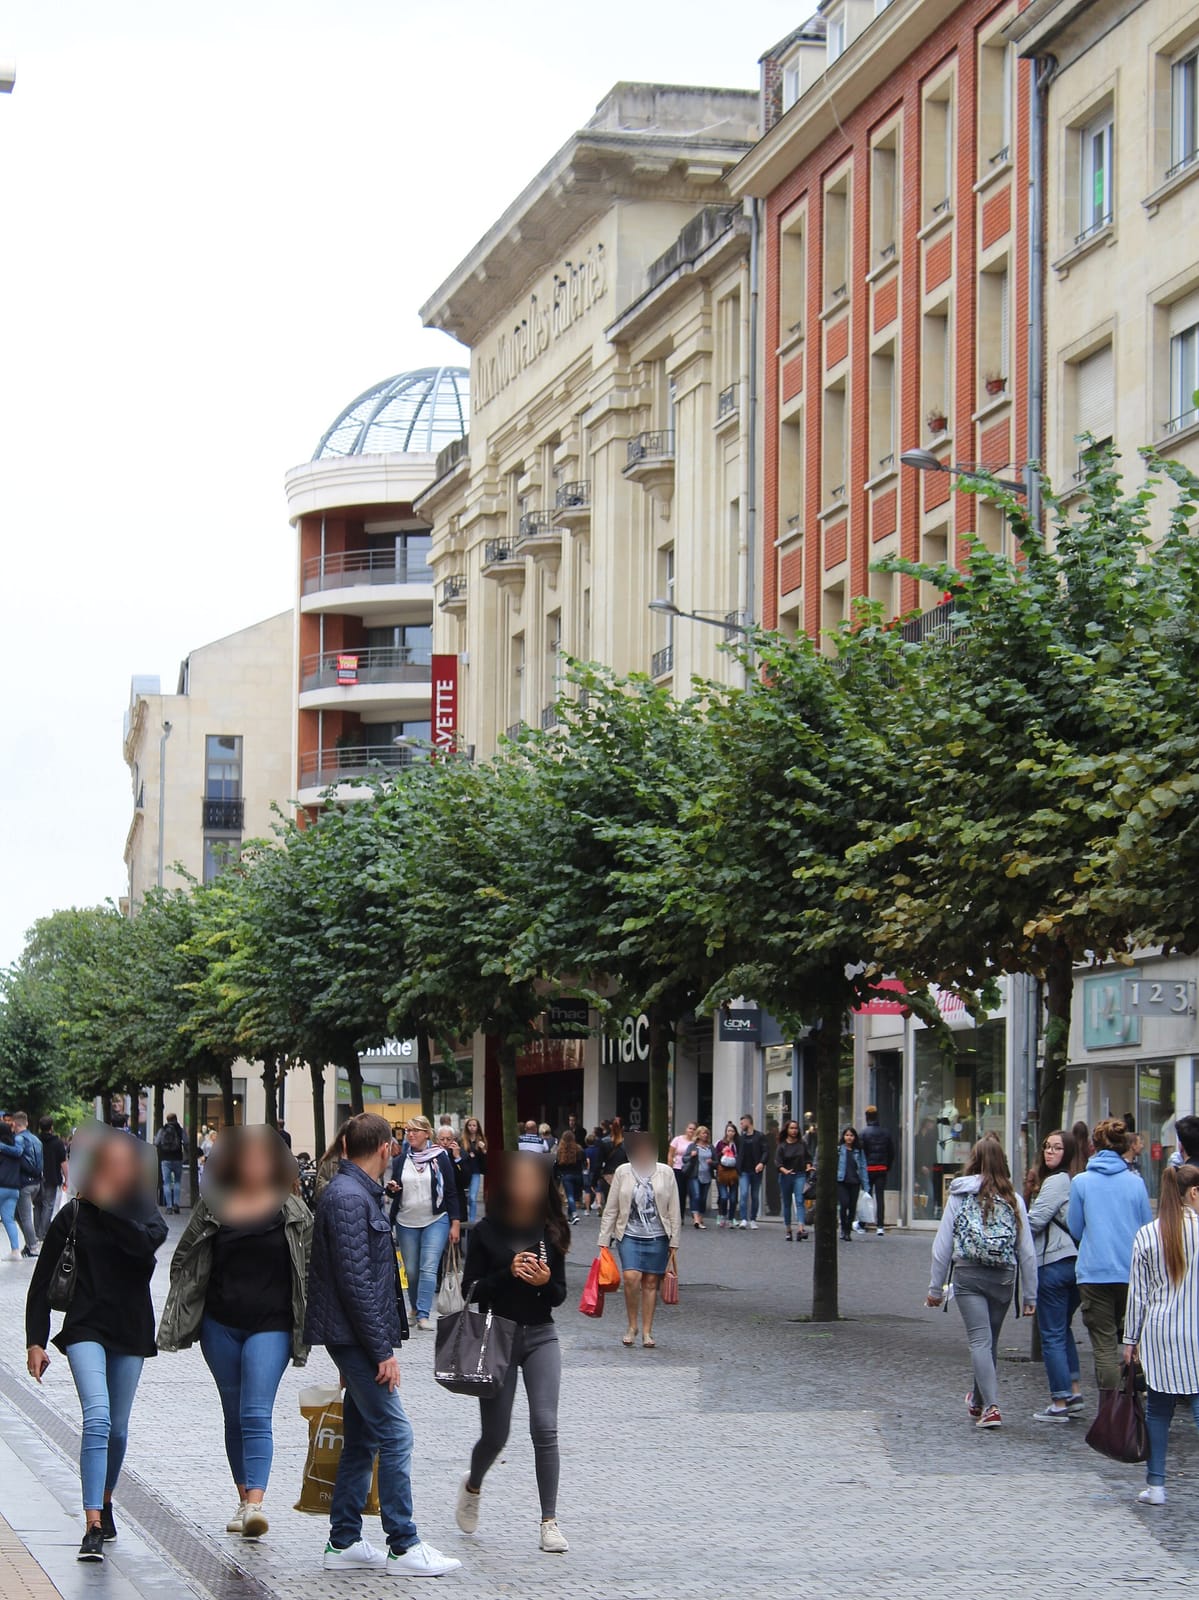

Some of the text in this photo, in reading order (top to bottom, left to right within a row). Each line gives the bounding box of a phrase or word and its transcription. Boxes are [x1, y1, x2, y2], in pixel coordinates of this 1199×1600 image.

[498, 293, 551, 396] Nouvelles
[551, 1007, 586, 1020] fnac
[723, 1019, 751, 1028] GDM
